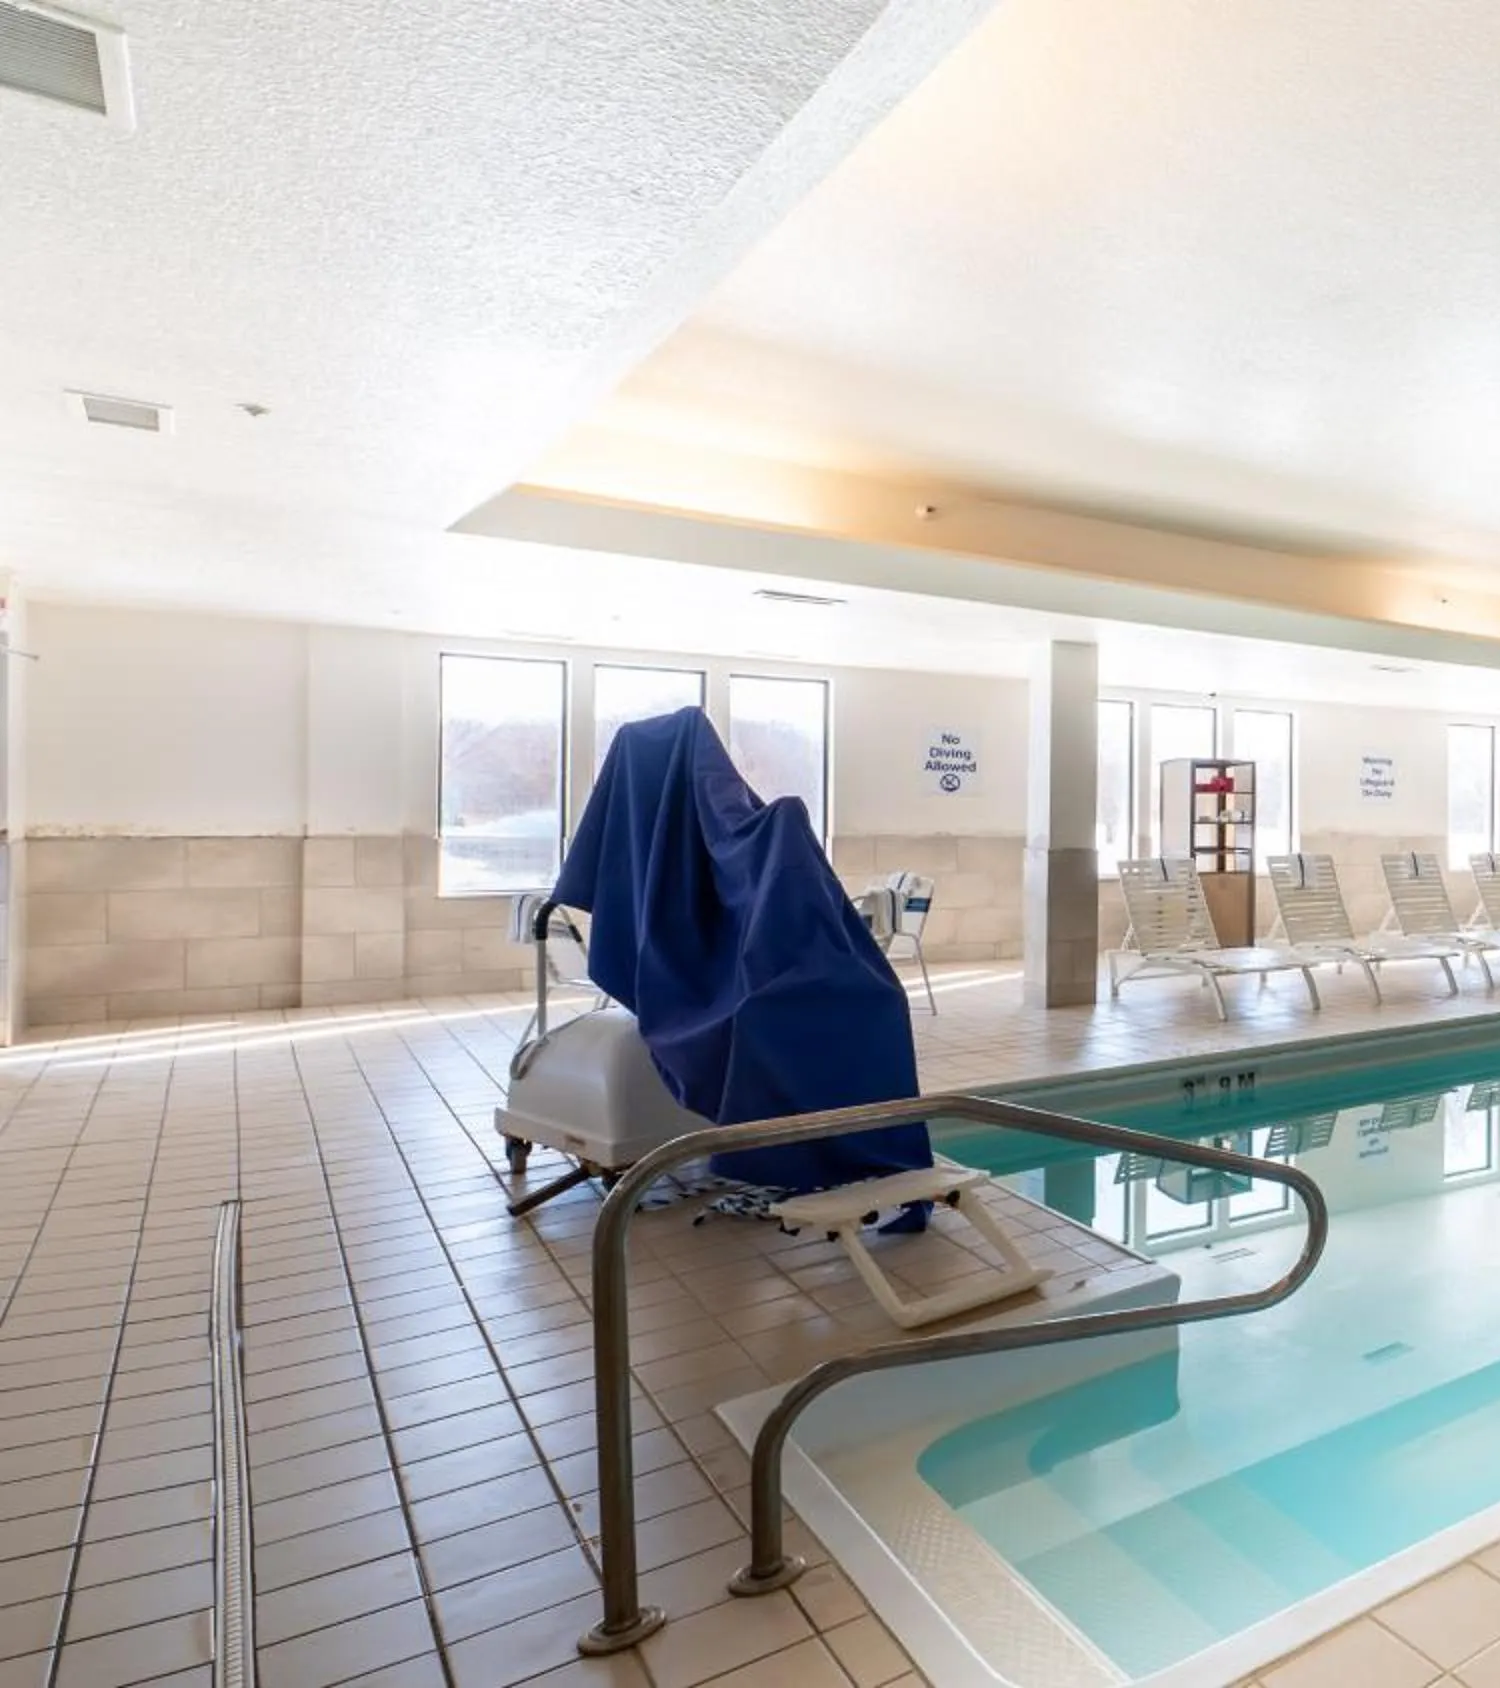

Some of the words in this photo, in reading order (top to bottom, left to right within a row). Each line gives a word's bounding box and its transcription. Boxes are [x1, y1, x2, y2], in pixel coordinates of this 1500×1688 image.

[941, 734, 960, 745] No
[929, 747, 971, 760] Diving
[924, 760, 977, 772] Allowed
